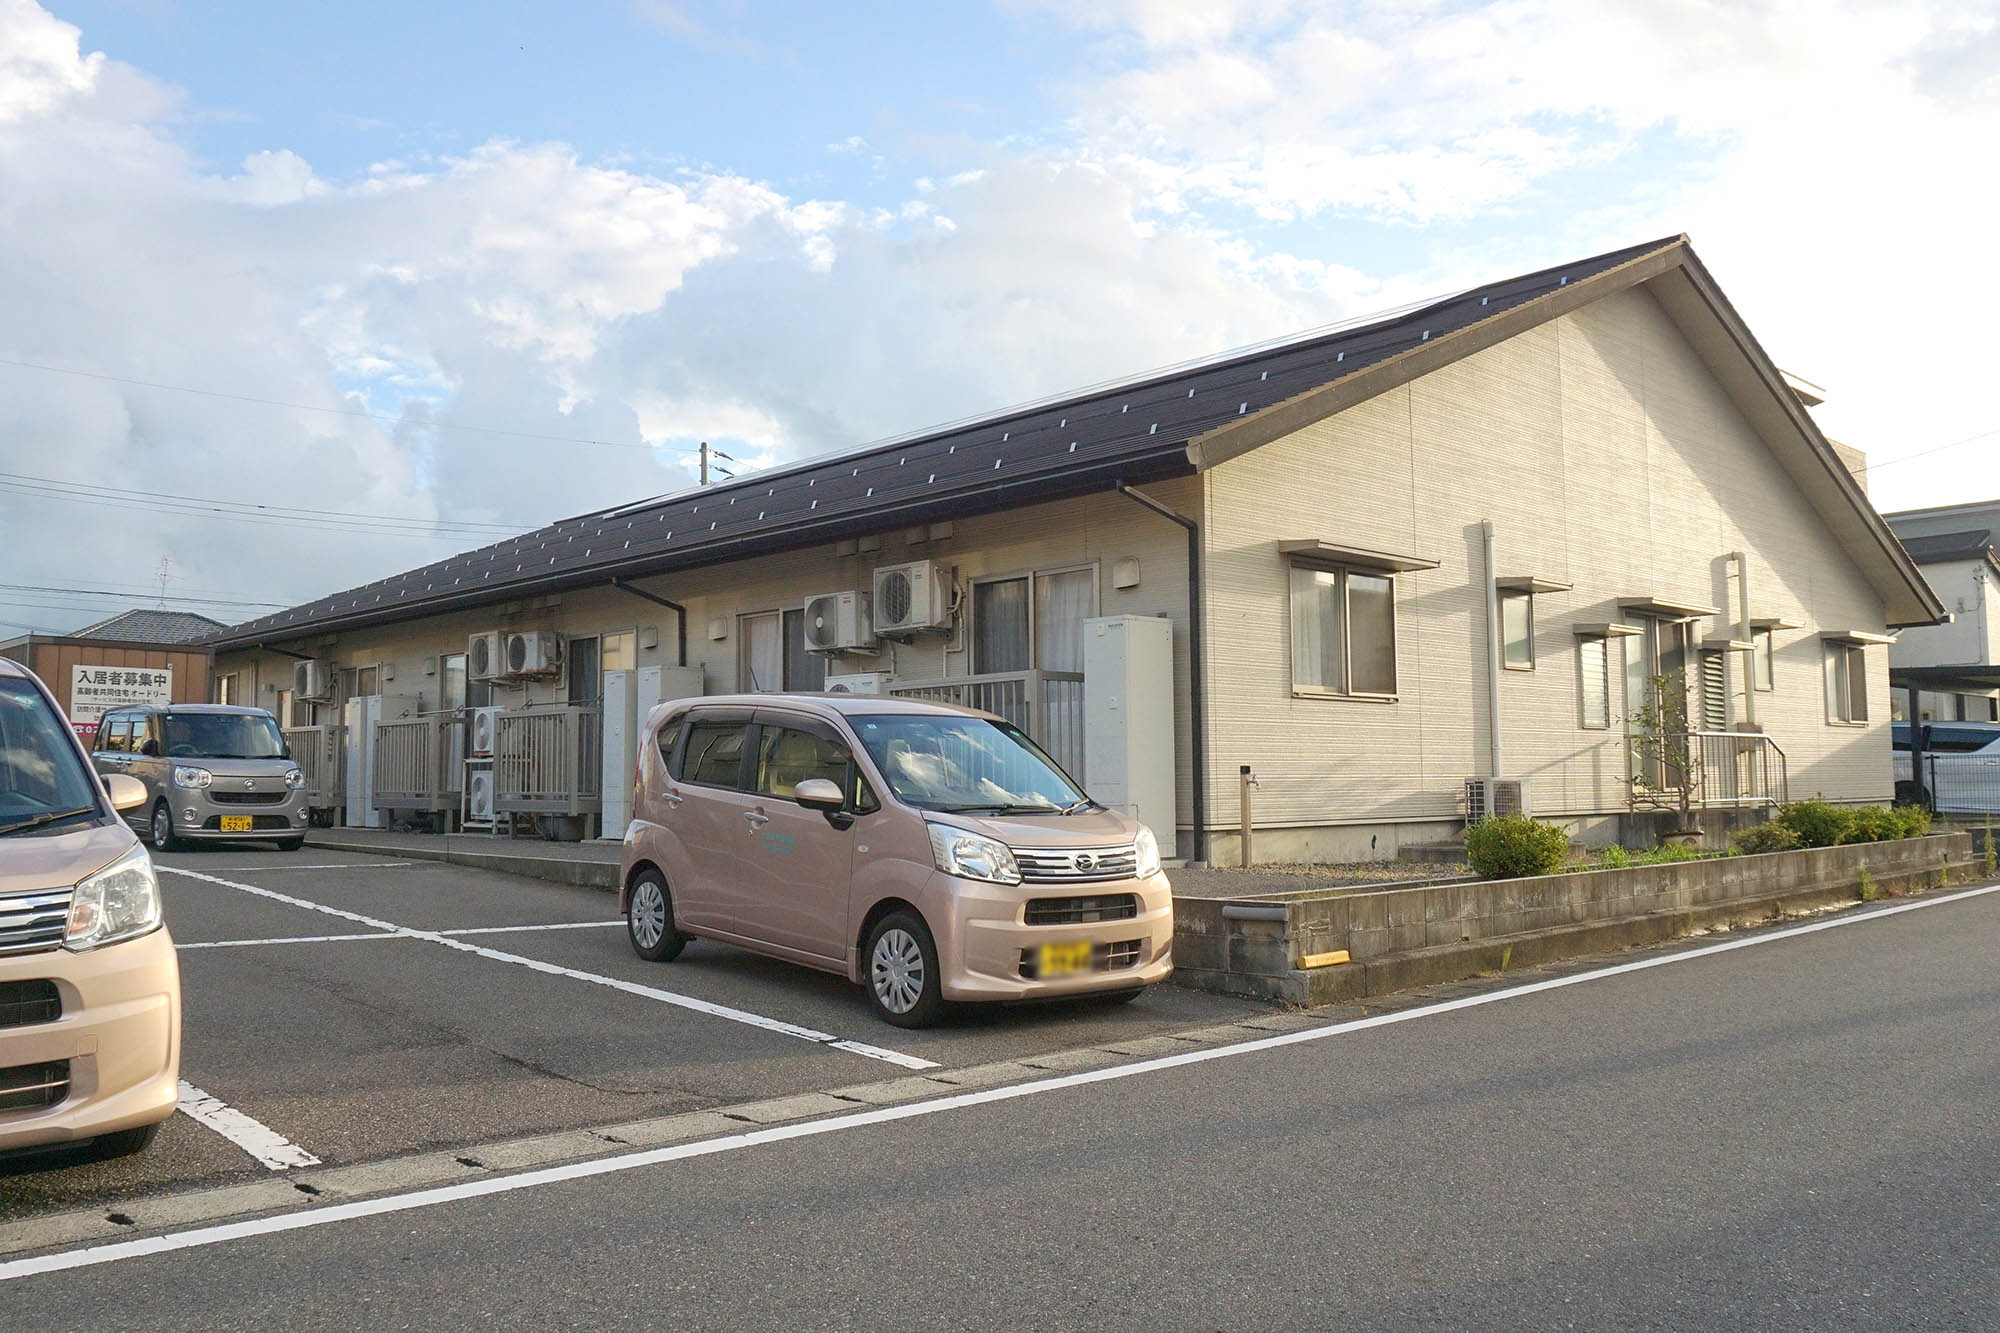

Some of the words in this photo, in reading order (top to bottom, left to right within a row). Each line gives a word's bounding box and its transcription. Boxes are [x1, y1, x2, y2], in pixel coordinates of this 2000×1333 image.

[77, 670, 167, 687] 入居者募集中
[77, 687, 129, 697] 高齢者共同住宅
[130, 689, 167, 698] オードリー
